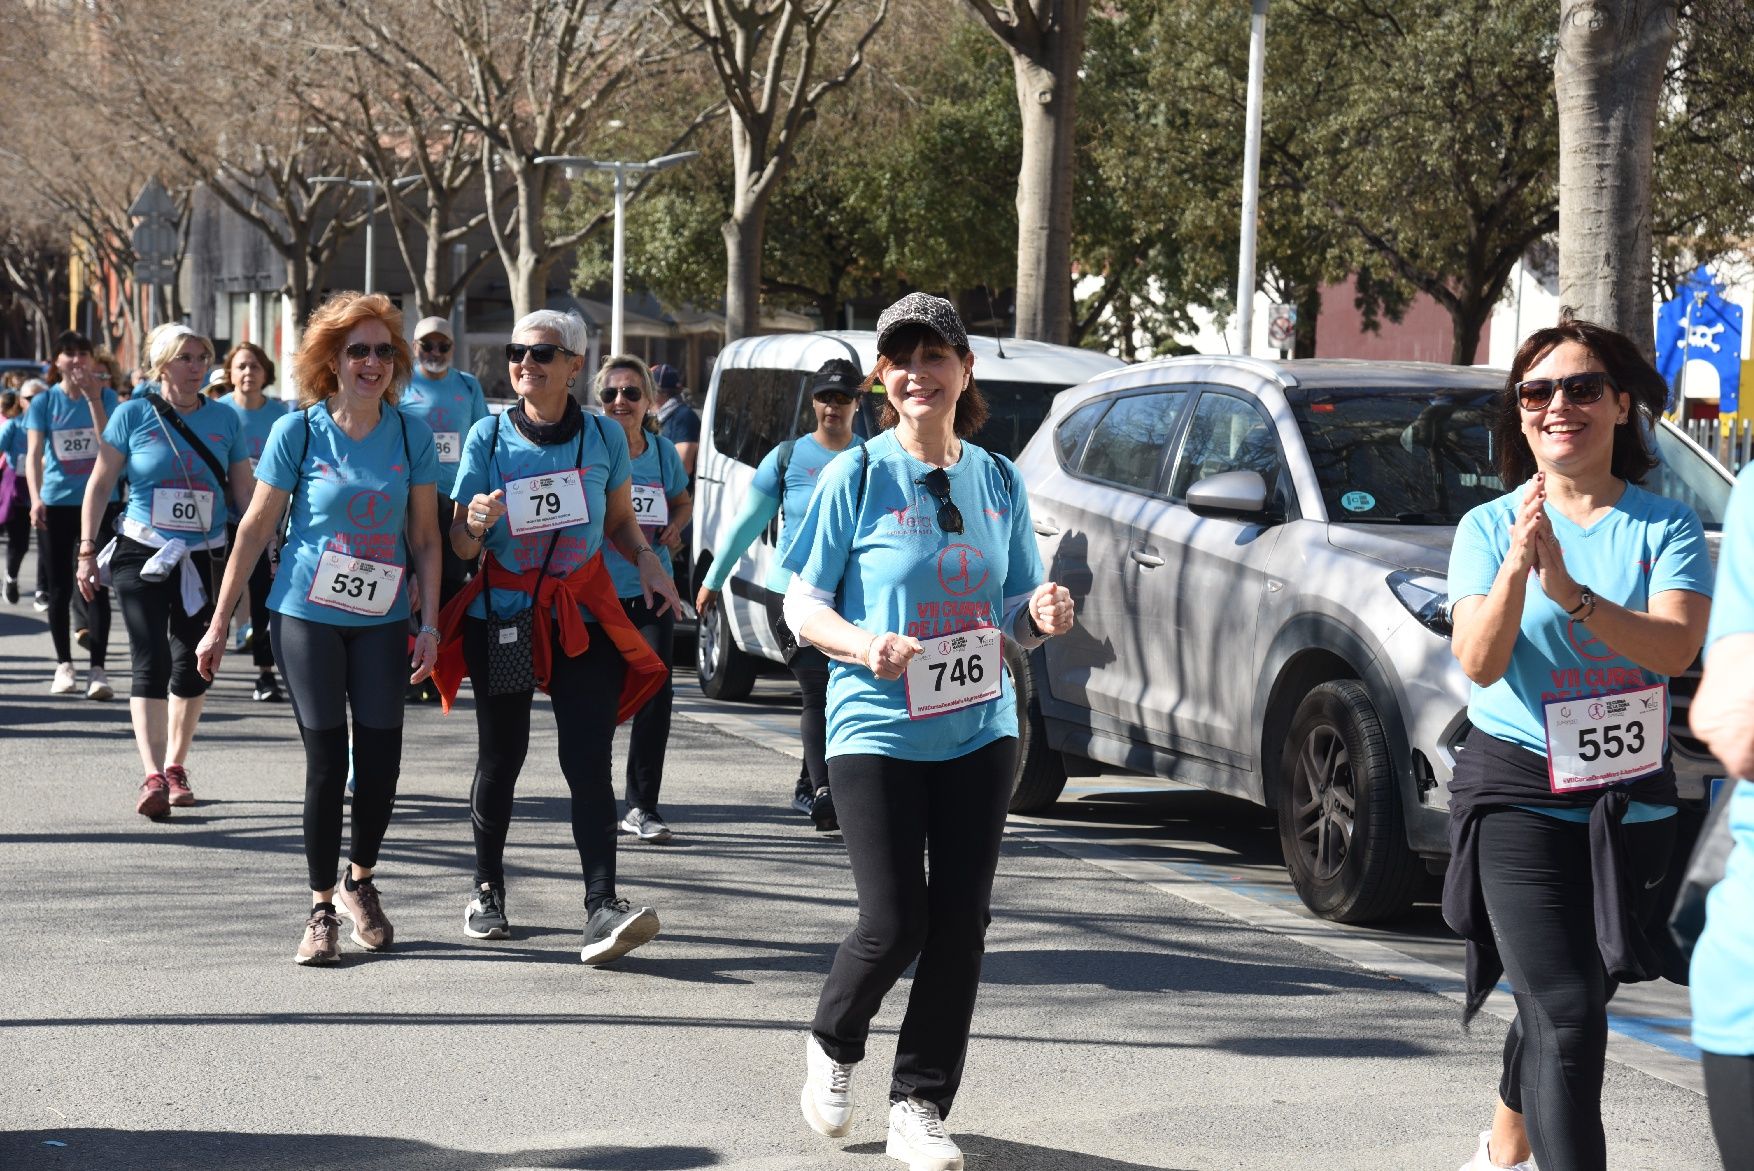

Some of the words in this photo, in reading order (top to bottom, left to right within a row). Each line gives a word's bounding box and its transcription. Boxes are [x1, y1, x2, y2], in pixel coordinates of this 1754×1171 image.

[63, 438, 91, 452] 287
[172, 502, 196, 520] 60
[529, 492, 561, 517] 79
[632, 497, 655, 513] 37
[331, 572, 378, 601] 531
[917, 601, 939, 619] VII
[942, 600, 991, 618] CURSA
[929, 654, 984, 692] 746
[1552, 668, 1579, 689] VII
[1585, 667, 1646, 687] CURS
[1578, 720, 1645, 762] 553
